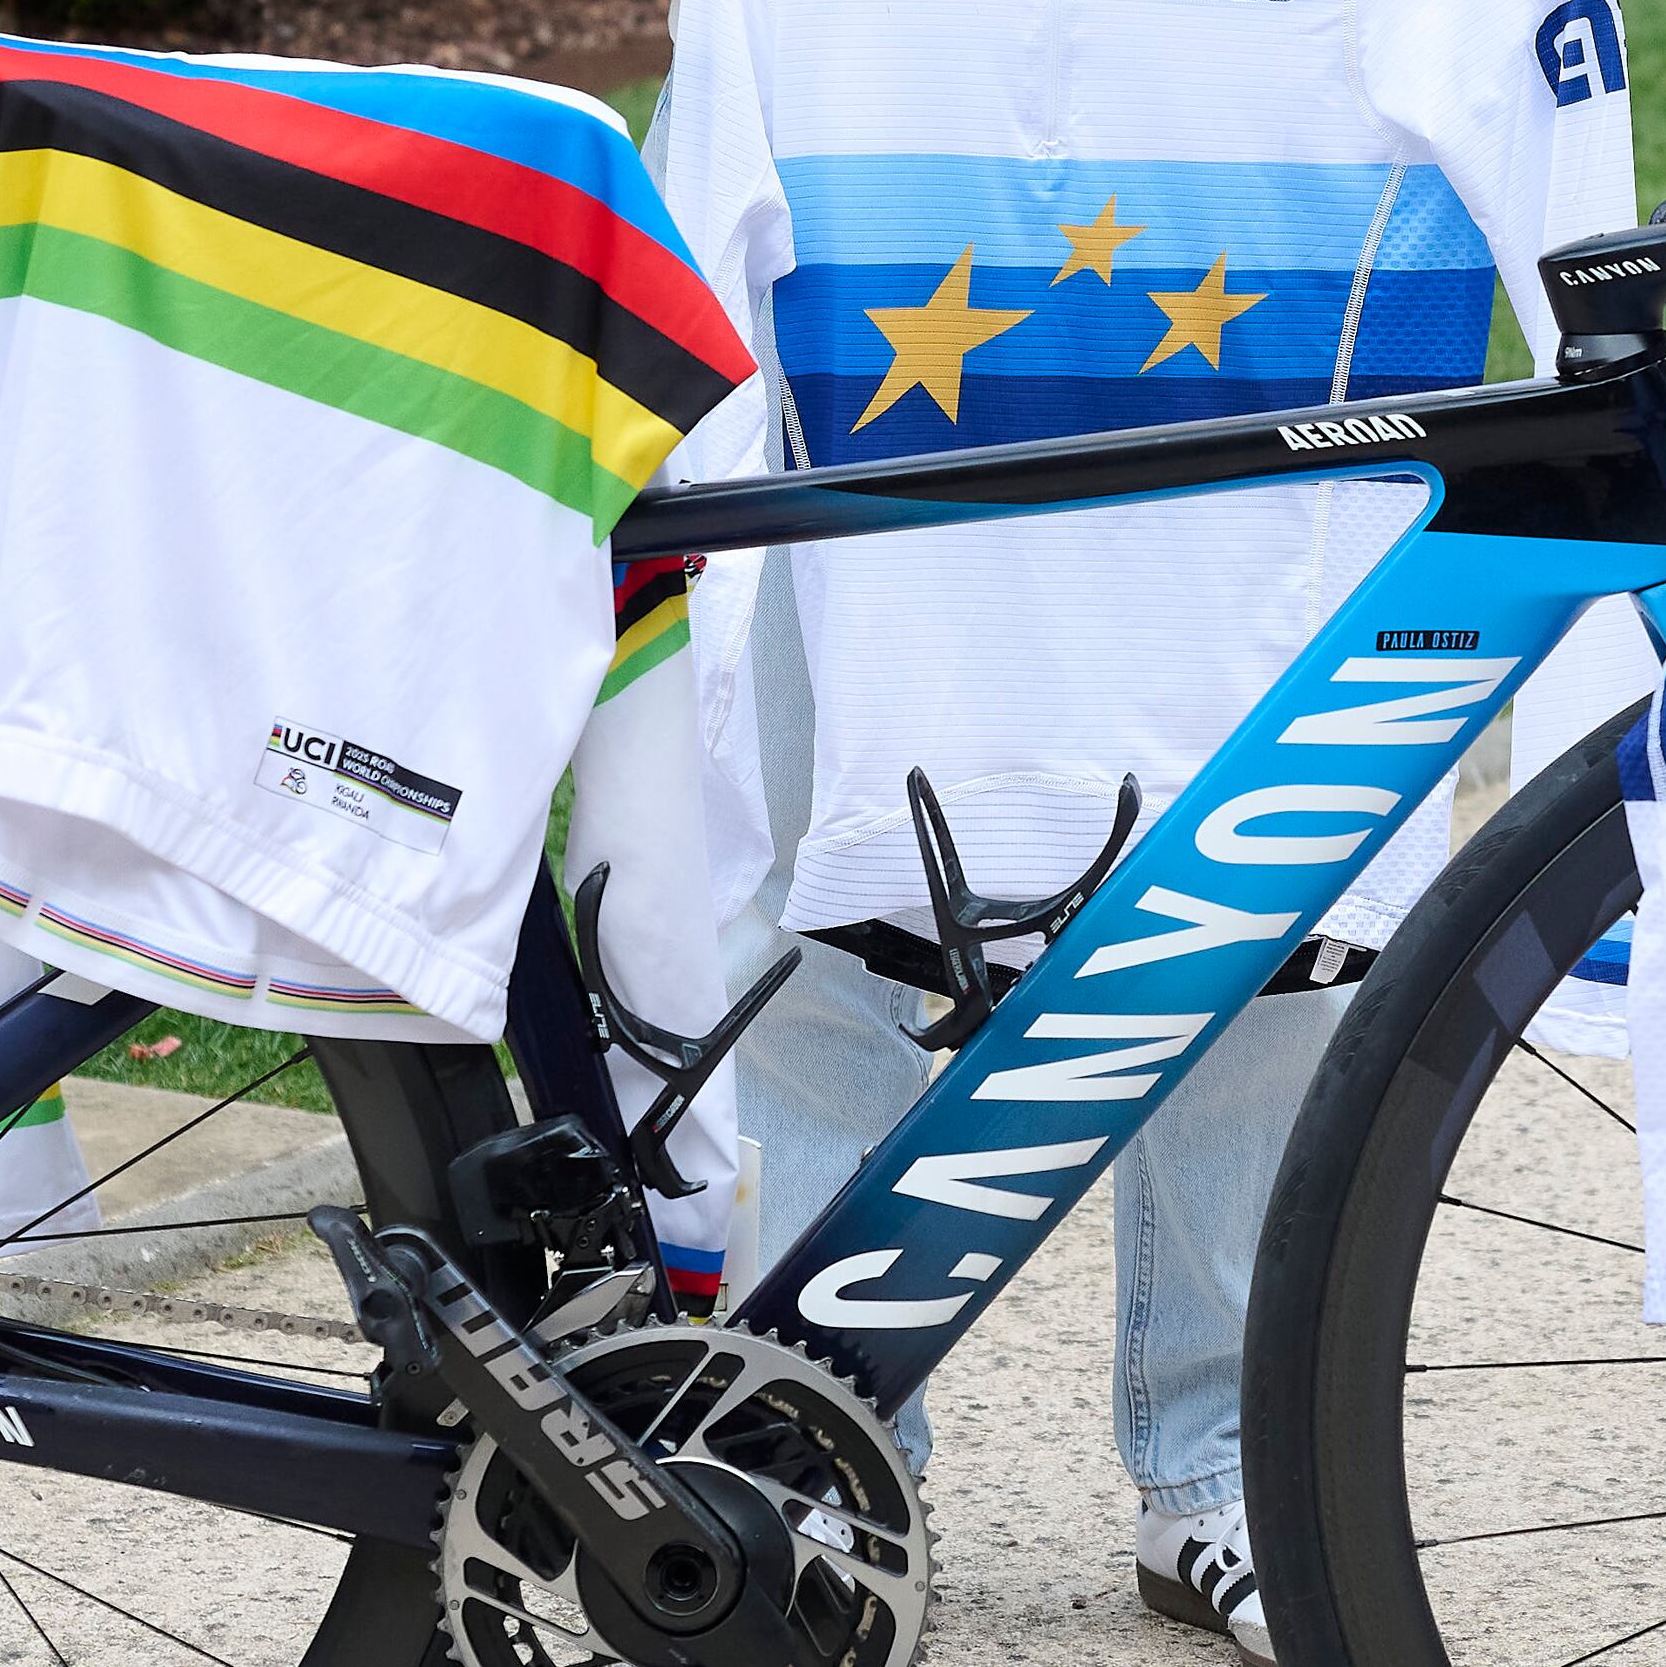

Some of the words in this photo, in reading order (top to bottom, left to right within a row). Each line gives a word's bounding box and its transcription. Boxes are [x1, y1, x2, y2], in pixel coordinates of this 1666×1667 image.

[1559, 257, 1662, 286] CANYON
[1277, 413, 1427, 451] AEROAD
[1382, 632, 1424, 649] PAULA
[1431, 631, 1476, 649] OSTIZ
[283, 727, 336, 764] UCI
[345, 746, 369, 764] 2025
[341, 758, 382, 781] WORLD
[1050, 891, 1085, 934] ELITE
[798, 656, 1521, 1329] CANYON
[429, 1262, 667, 1521] SRAM
